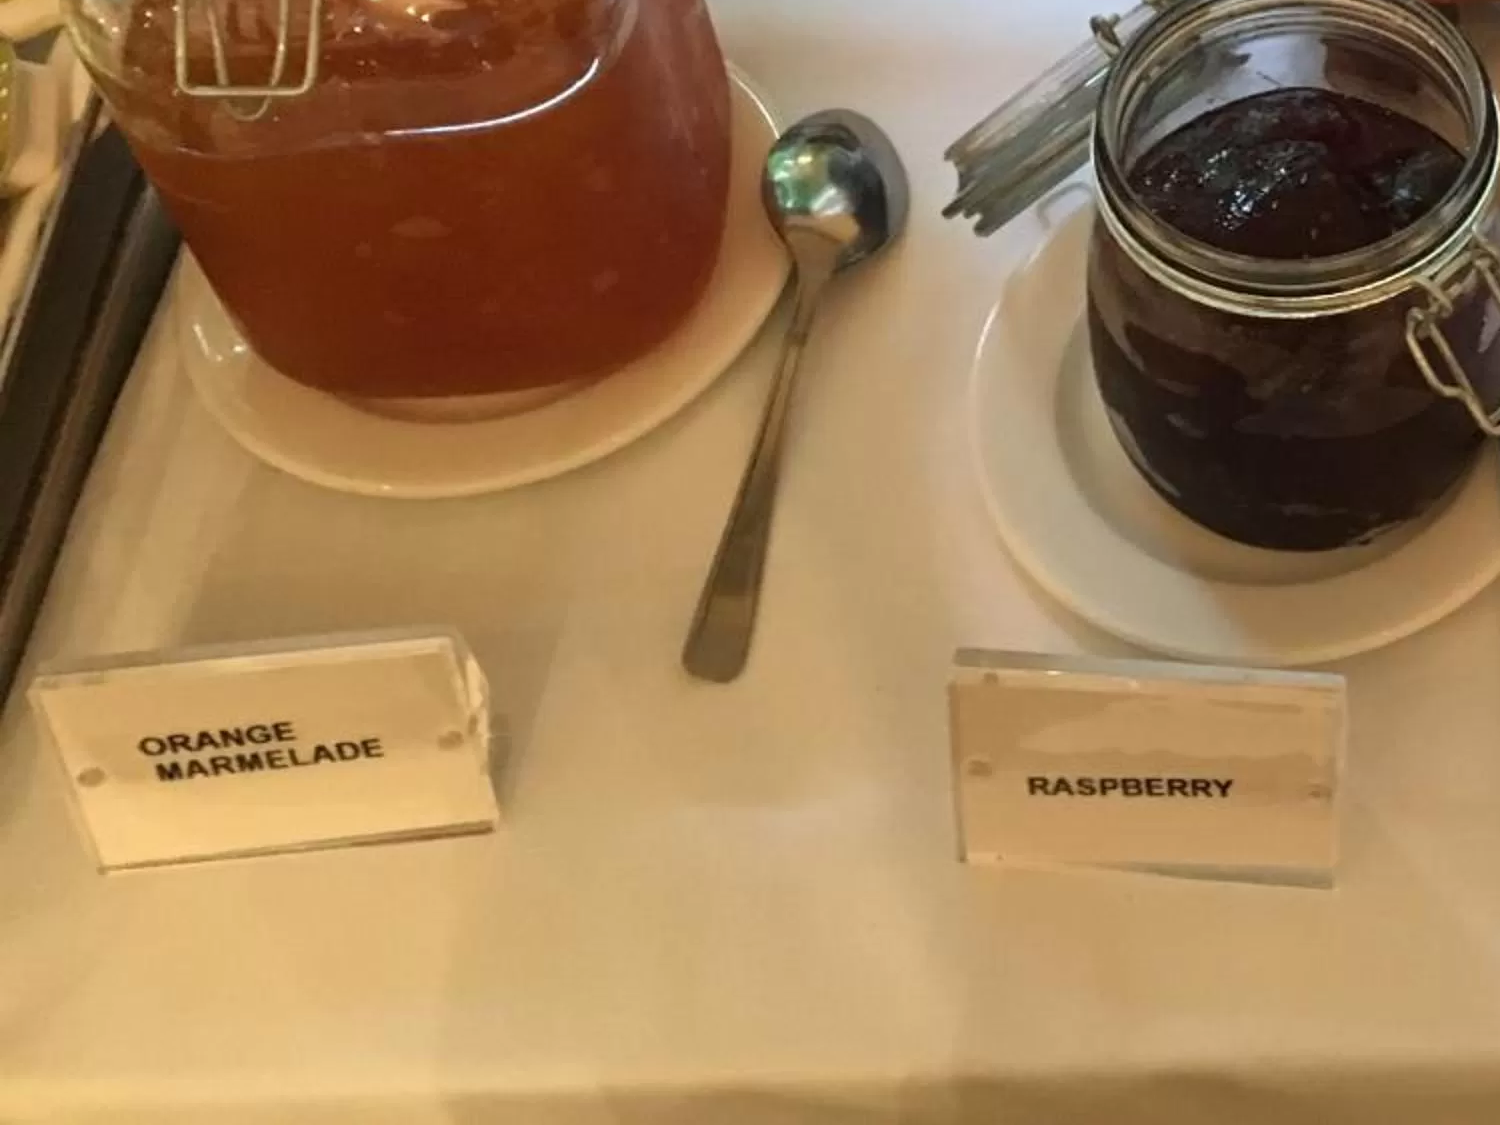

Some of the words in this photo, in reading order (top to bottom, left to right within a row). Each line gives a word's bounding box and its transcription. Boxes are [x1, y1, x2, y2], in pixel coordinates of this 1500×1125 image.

[138, 721, 296, 756] ORANGE
[155, 738, 384, 781] MARMELADE
[1027, 776, 1233, 797] RASPBERRY
